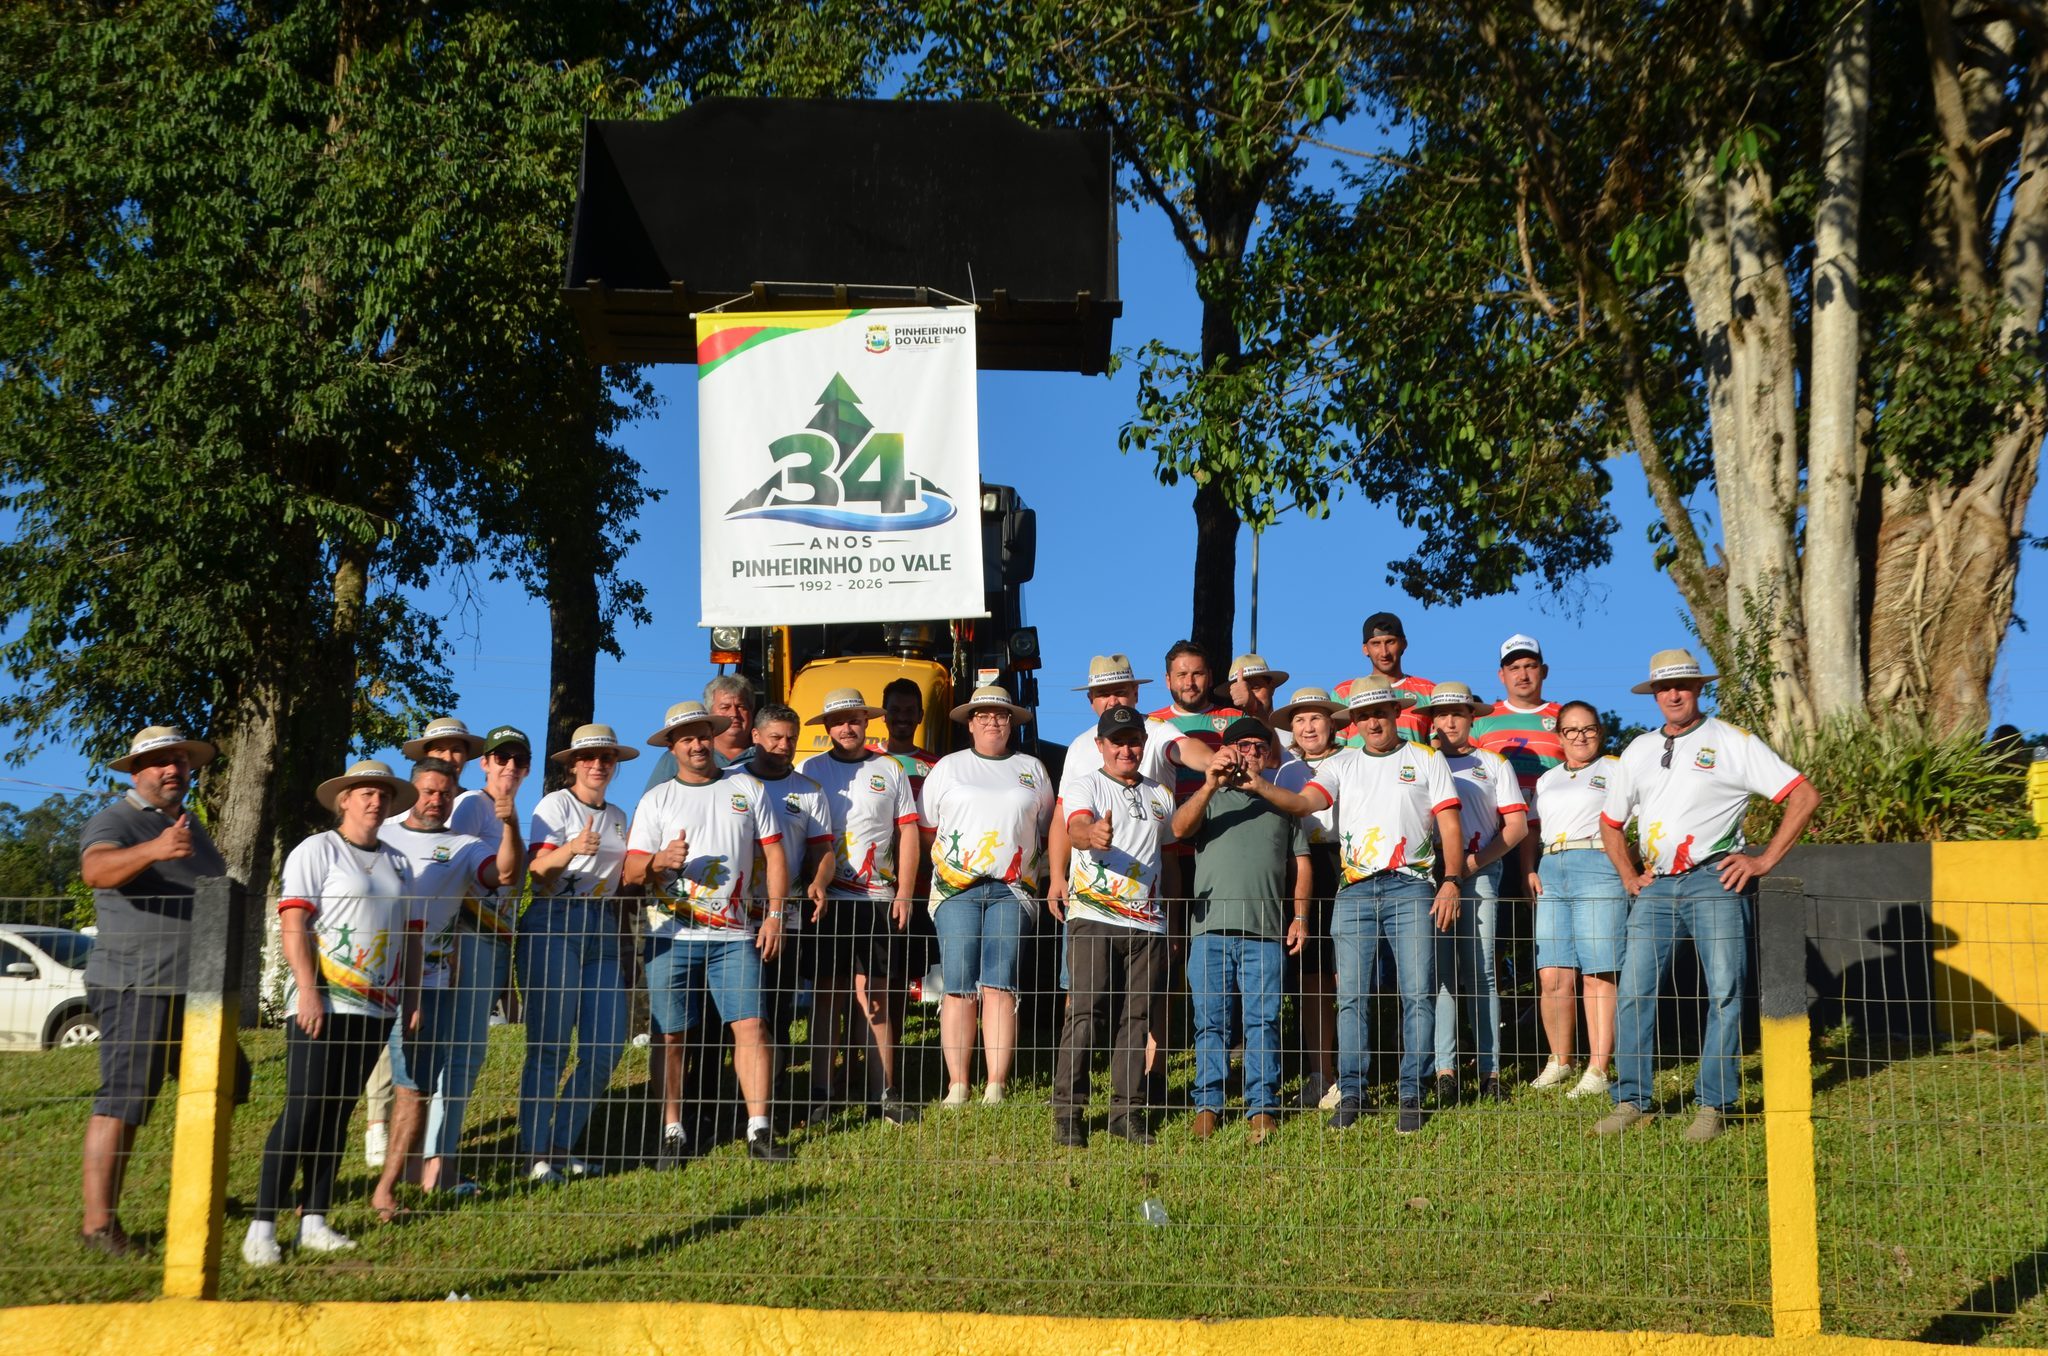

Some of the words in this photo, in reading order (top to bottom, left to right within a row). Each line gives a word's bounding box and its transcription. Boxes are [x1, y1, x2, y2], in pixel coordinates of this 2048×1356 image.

[895, 326, 966, 336] PINHEIRINHO
[895, 337, 912, 345] DO
[913, 336, 941, 345] VALE
[768, 432, 916, 514] 34
[809, 535, 873, 550] ANOS
[732, 556, 863, 578] PINHEIRINHO
[869, 556, 896, 573] DO
[901, 554, 952, 572] VALE
[799, 580, 832, 592] 1992
[848, 578, 883, 590] 2026
